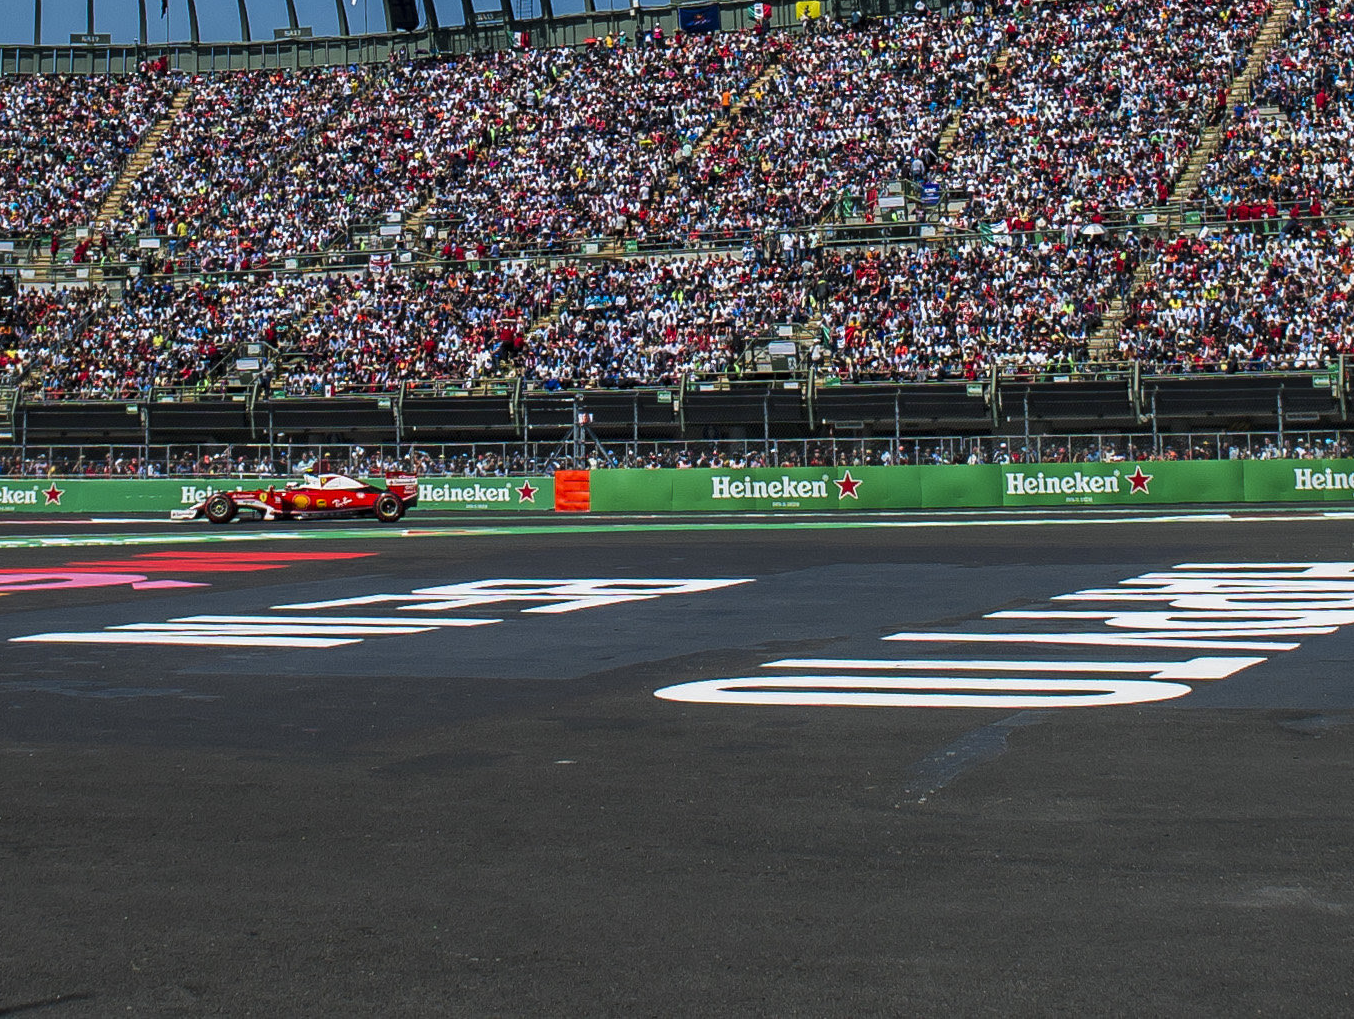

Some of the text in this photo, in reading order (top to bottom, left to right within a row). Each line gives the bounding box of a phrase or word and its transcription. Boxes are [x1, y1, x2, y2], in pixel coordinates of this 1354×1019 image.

[418, 483, 511, 502] Heineken
[712, 476, 827, 498] Heineken
[1006, 472, 1119, 494] Heineken
